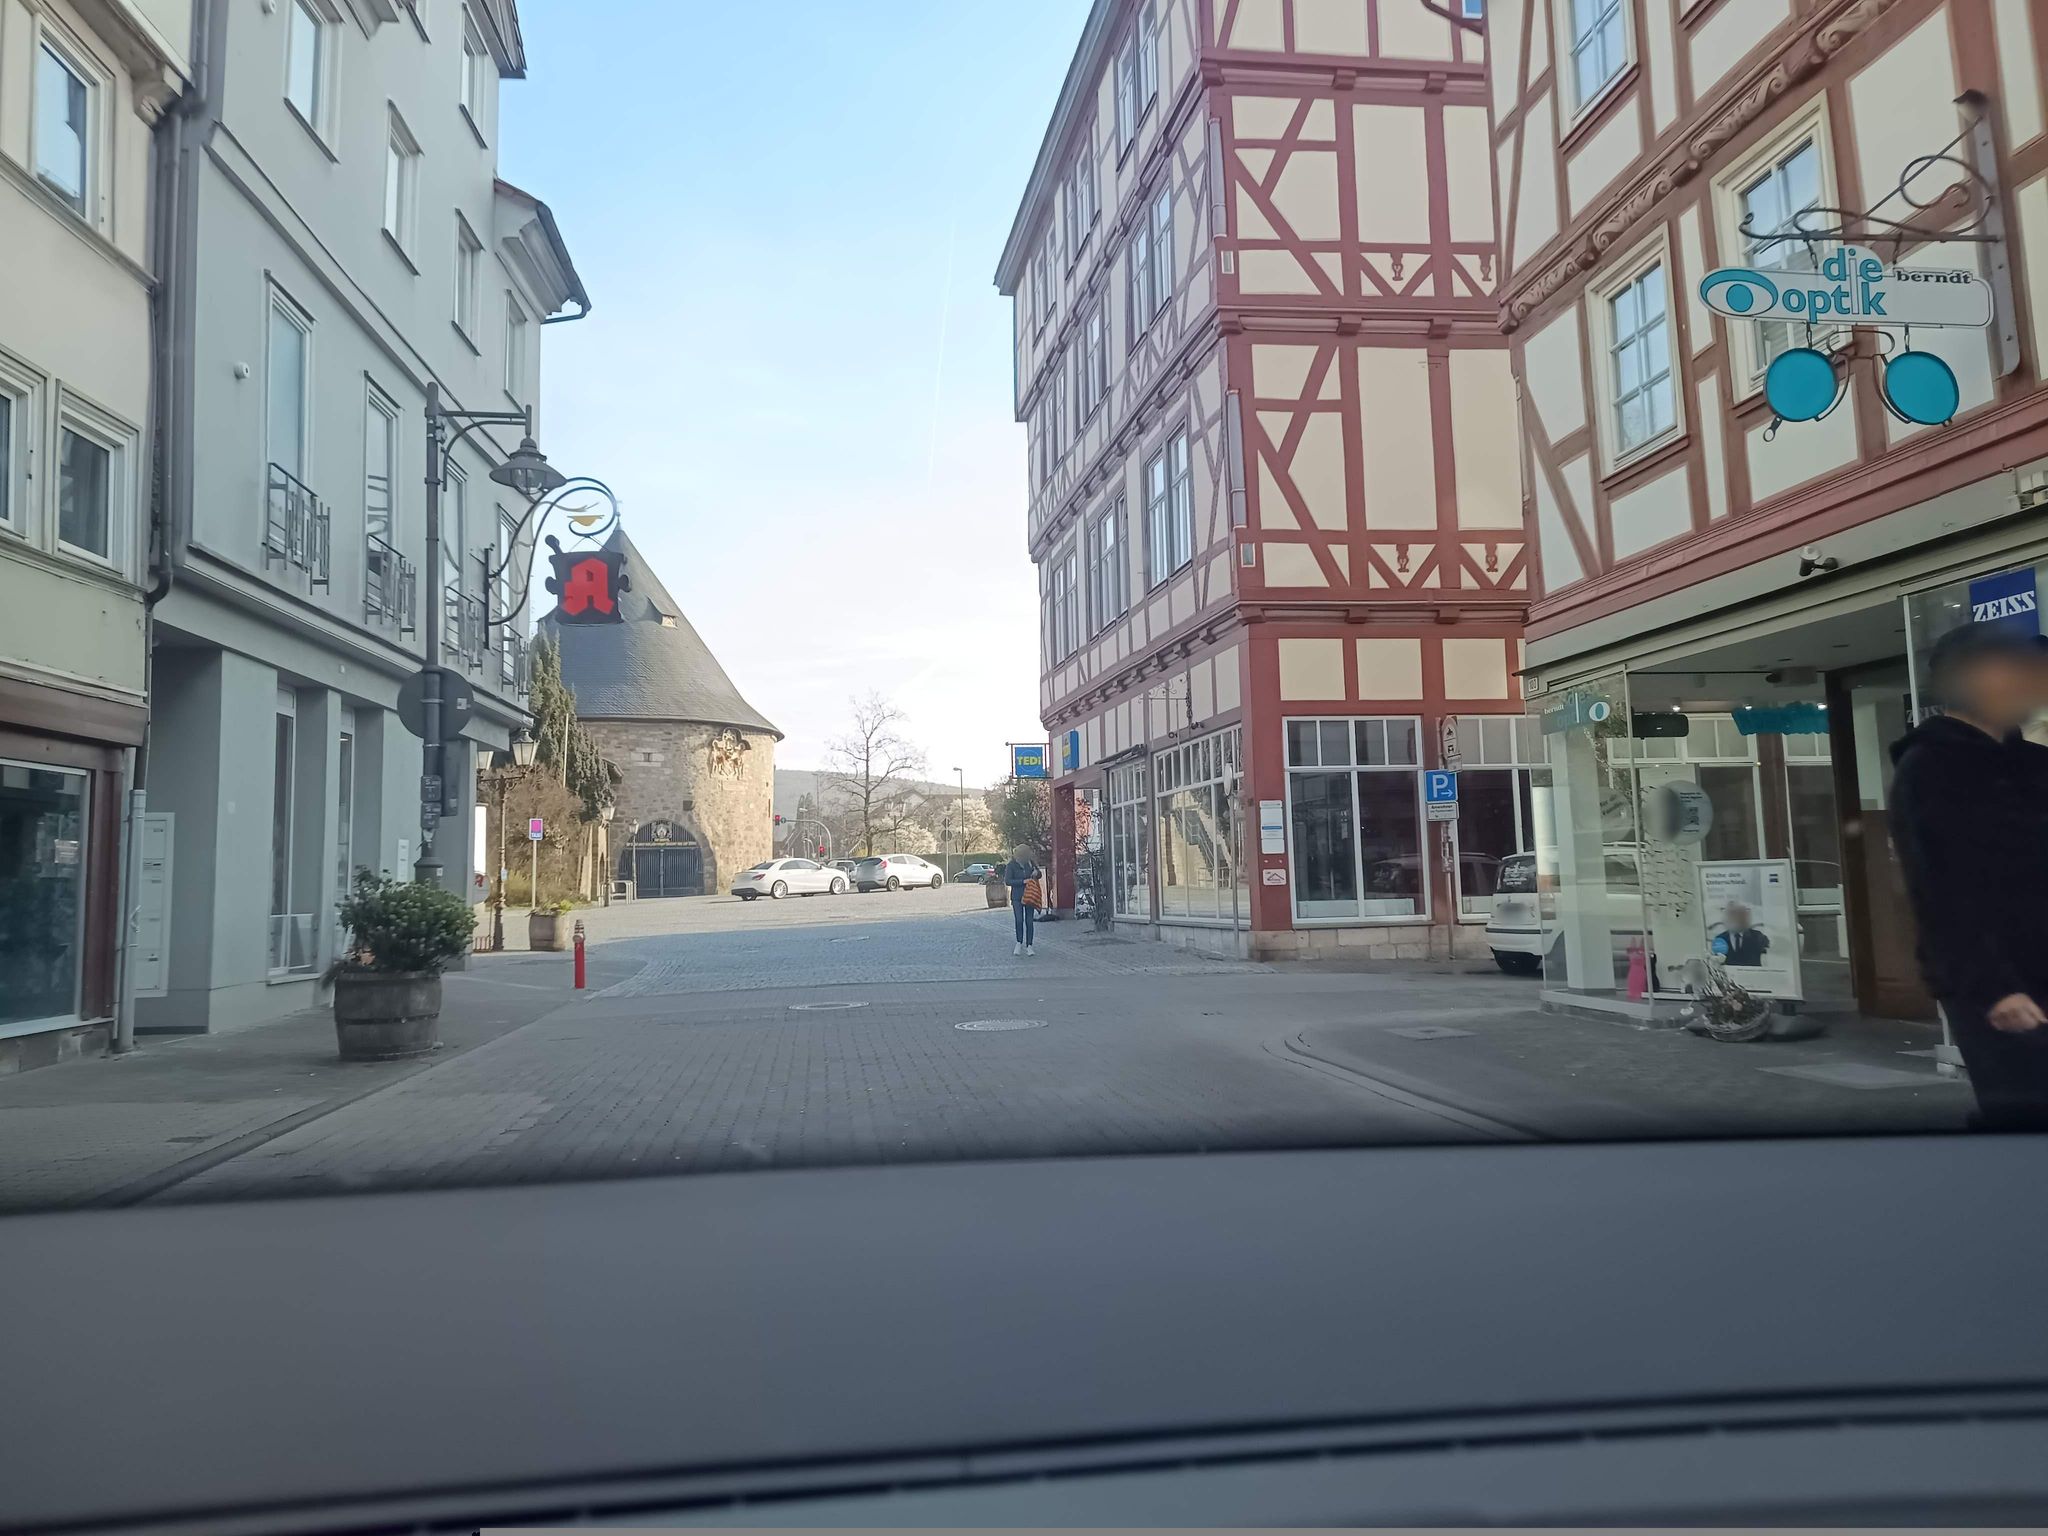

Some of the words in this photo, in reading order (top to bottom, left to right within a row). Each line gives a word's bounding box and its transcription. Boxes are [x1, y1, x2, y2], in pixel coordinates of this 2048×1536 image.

[1823, 248, 1883, 282] die
[1896, 270, 1972, 284] berndt
[1782, 282, 1887, 325] optik
[1973, 590, 2036, 623] ZEISS
[1432, 774, 1449, 798] P
